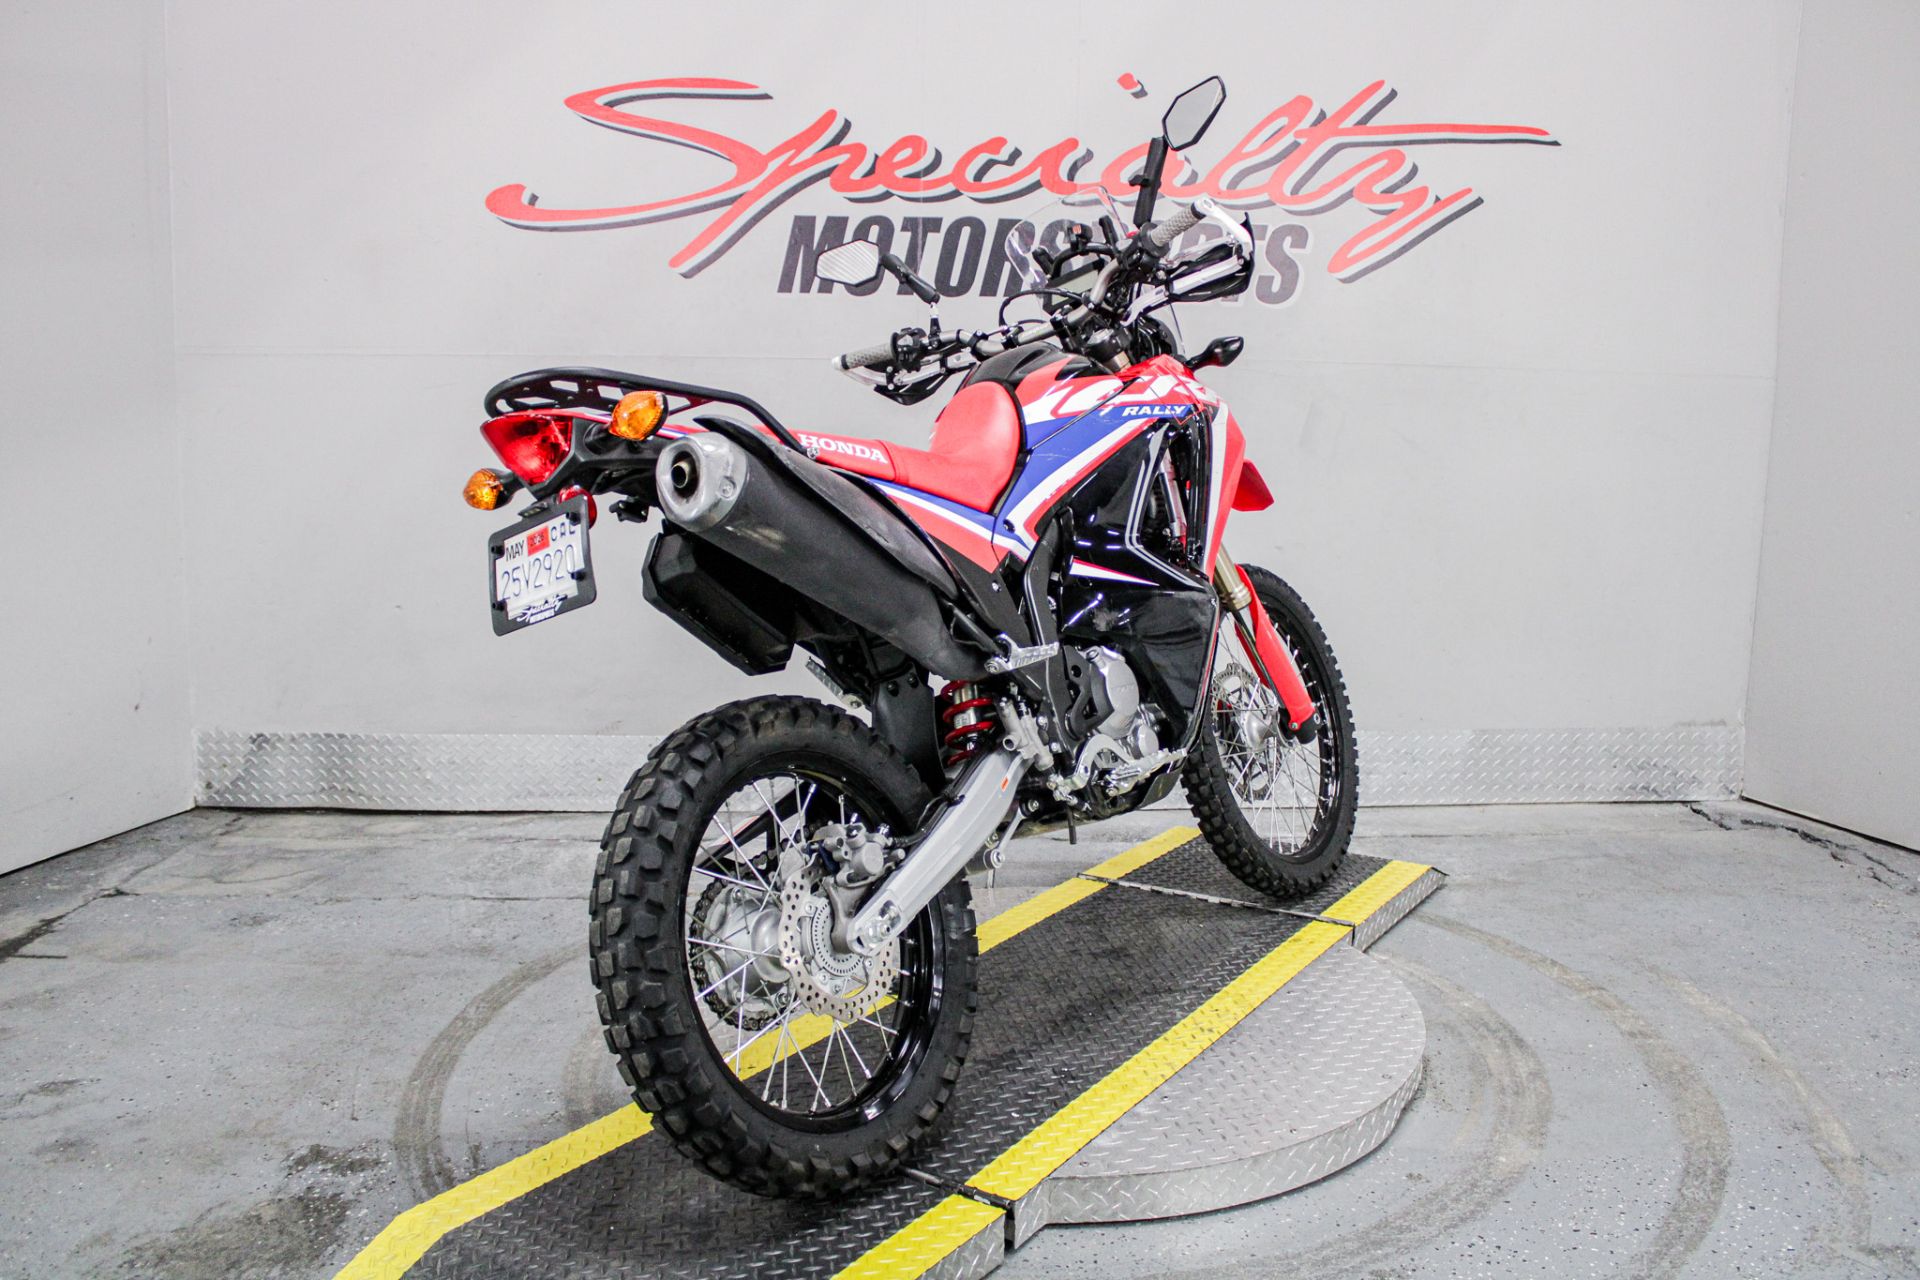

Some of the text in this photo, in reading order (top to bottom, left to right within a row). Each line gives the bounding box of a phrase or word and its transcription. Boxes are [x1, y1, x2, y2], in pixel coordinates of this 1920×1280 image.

[485, 73, 1562, 284] Specialty
[777, 212, 1310, 309] MOTORSS
[1122, 405, 1187, 417] RALLY
[797, 433, 889, 464] HONDA
[501, 544, 576, 600] 25V2920
[505, 540, 525, 562] MAY
